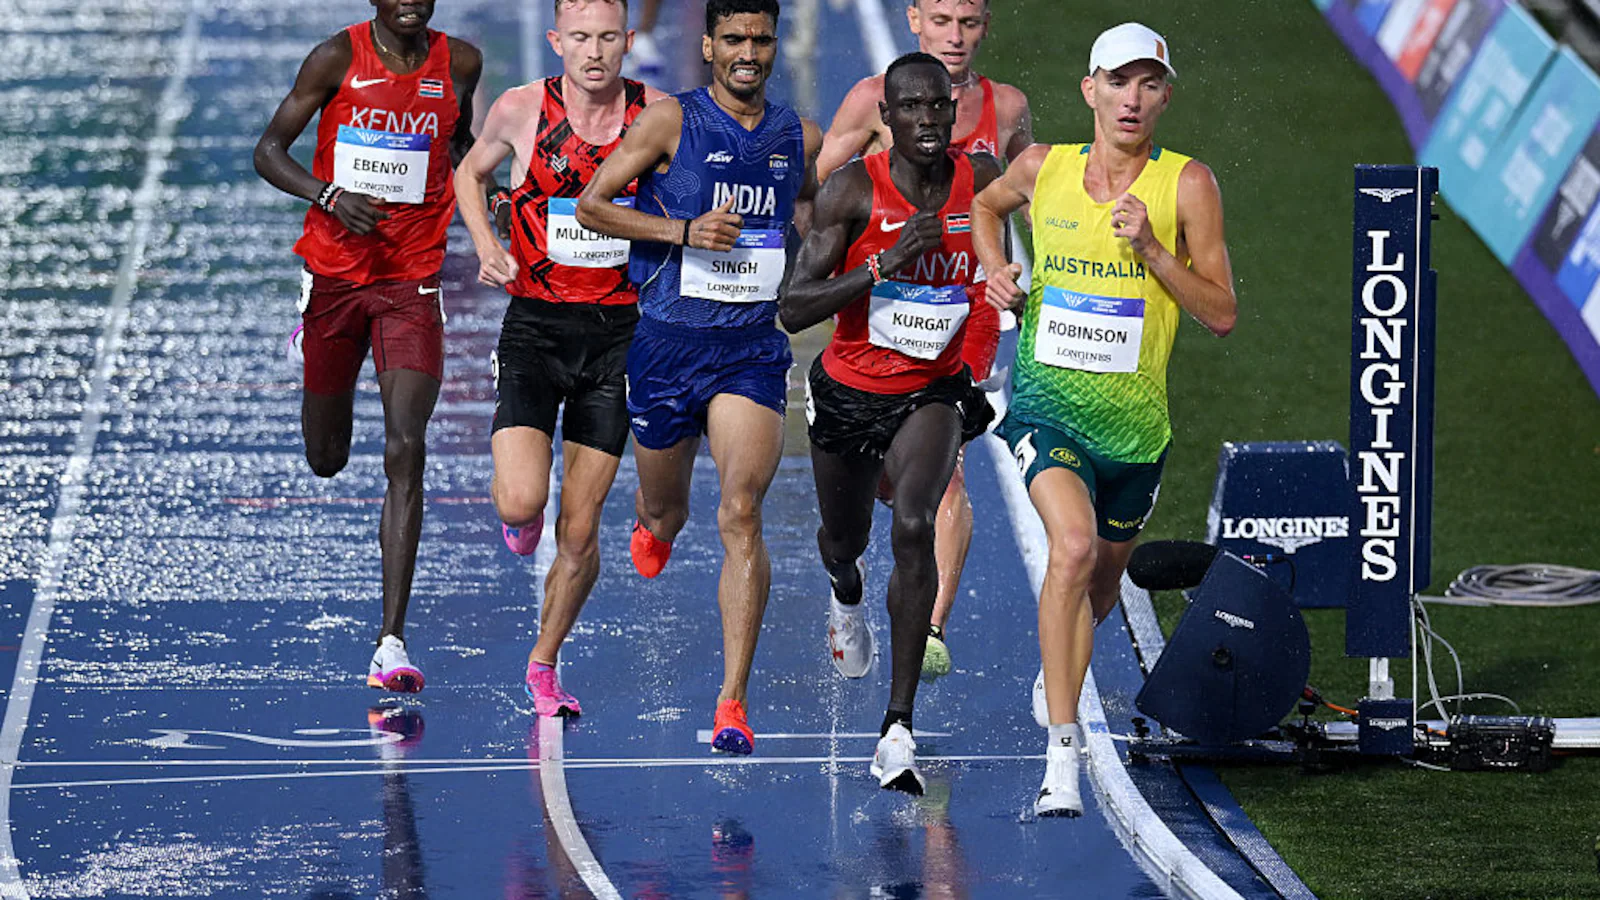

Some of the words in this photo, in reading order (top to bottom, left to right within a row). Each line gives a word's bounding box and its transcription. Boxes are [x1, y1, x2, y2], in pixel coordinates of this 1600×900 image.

[349, 105, 439, 138] KENYA
[352, 158, 408, 175] EBENYO
[353, 180, 404, 193] LONGINES
[712, 182, 776, 216] INDIA
[572, 250, 625, 260] LONGINES
[711, 260, 758, 274] SINGH
[1043, 254, 1146, 280] AUSTRALIA
[707, 282, 760, 294] LONGINES
[892, 312, 952, 332] KURGAT
[1047, 319, 1128, 345] ROBINSON
[893, 335, 946, 351] LONGINES
[1055, 346, 1112, 362] LONGINES
[1357, 230, 1407, 581] LONGINES
